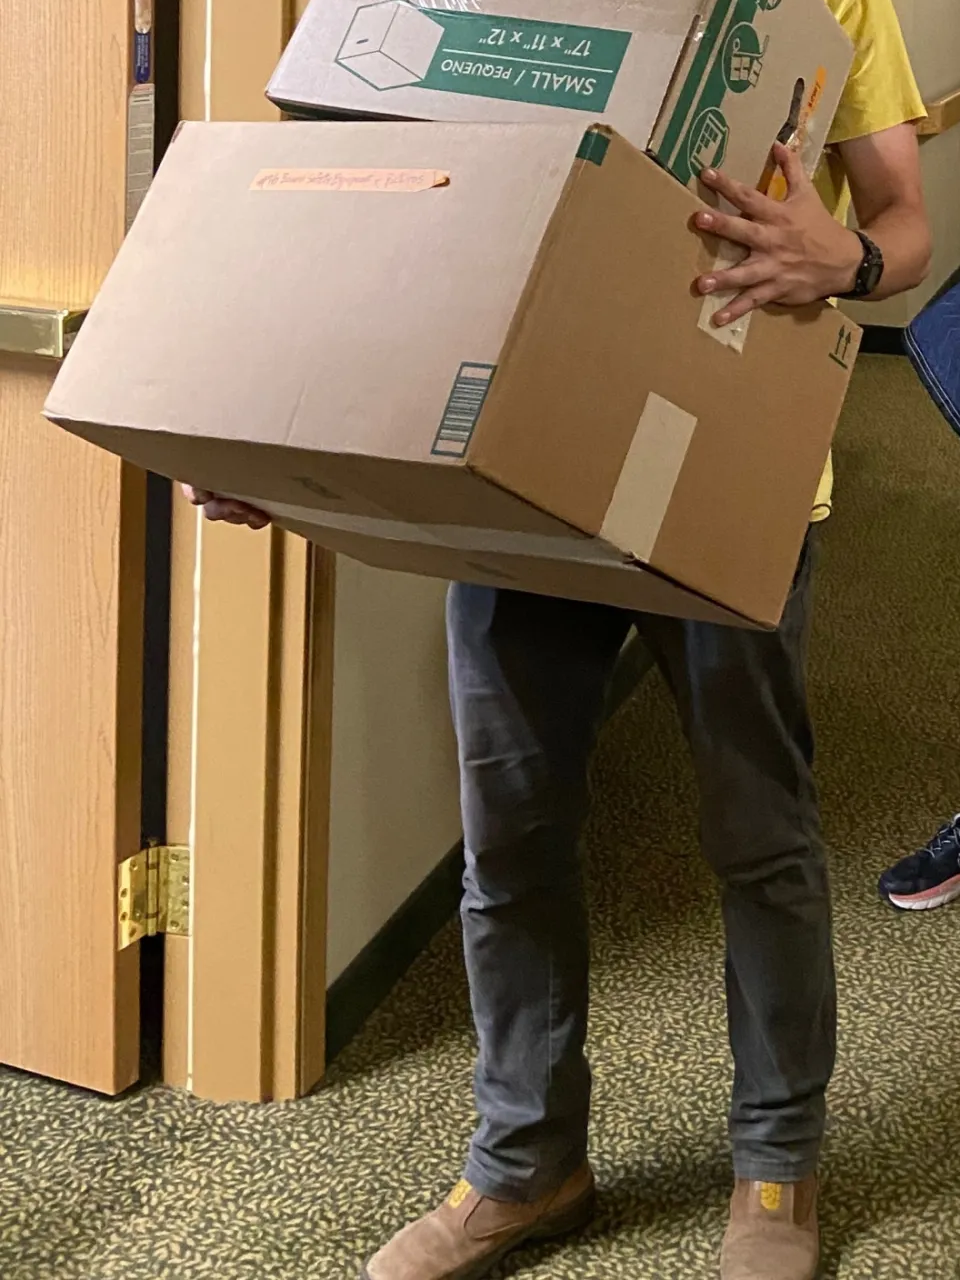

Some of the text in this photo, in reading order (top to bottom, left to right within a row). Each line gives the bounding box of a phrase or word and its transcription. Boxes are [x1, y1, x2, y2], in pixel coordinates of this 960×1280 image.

[478, 28, 592, 57] 17" x 11" x 12"
[441, 59, 597, 96] SMALL / PEQUEÑO
